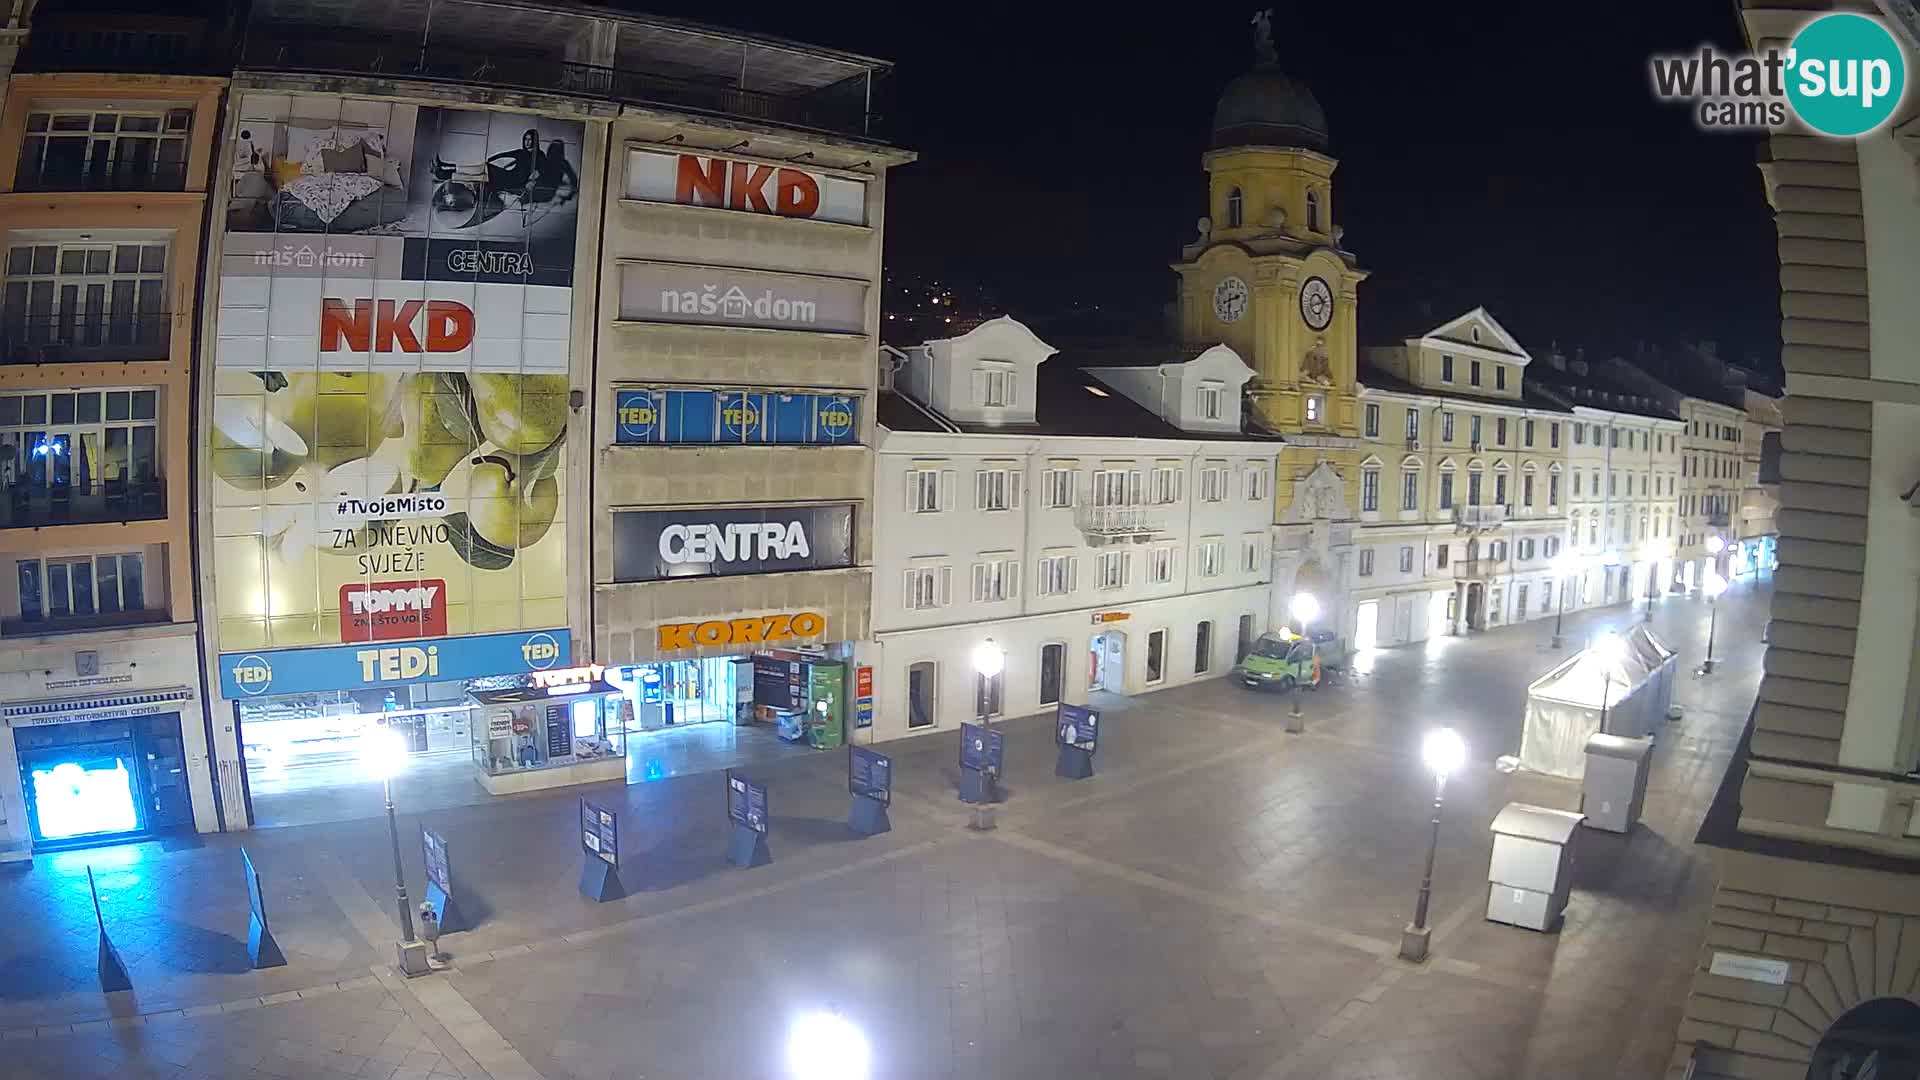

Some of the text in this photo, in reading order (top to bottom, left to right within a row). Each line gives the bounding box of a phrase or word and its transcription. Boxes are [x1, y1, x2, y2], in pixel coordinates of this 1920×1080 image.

[676, 154, 820, 218] NKD
[254, 246, 366, 268] naš dom
[448, 250, 534, 275] CENTRA
[661, 283, 815, 321] naš dom
[320, 298, 475, 353] NKD
[618, 408, 657, 425] TEDi
[723, 409, 759, 425] TEDi
[820, 411, 852, 426] TEDi
[337, 497, 445, 516] #TvojeMisto
[333, 524, 449, 549] ZA DNEVNO
[658, 520, 810, 564] CENTRA
[359, 548, 425, 575] SVJEŽE
[348, 586, 438, 614] TOMMY
[657, 612, 826, 651] KORZO
[357, 646, 439, 682] TEDi
[521, 642, 560, 661] TEDi
[232, 666, 272, 684] TEDi
